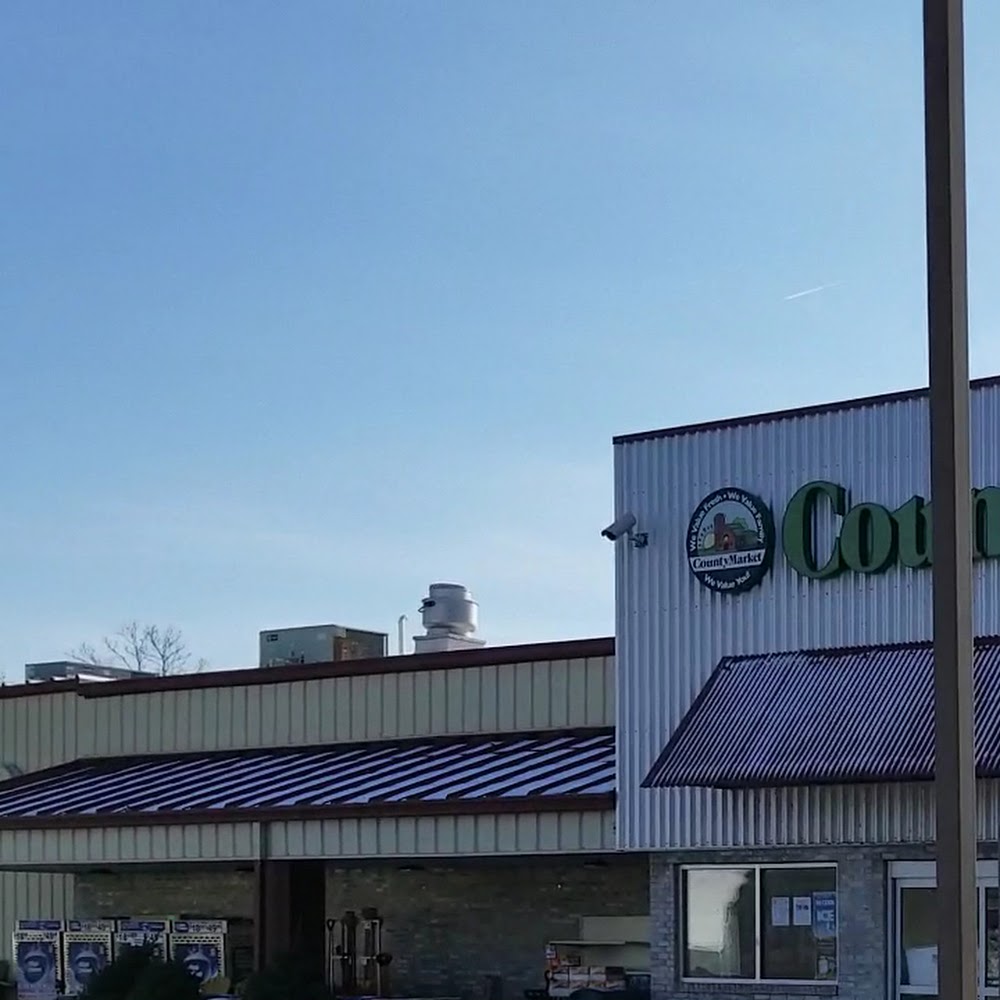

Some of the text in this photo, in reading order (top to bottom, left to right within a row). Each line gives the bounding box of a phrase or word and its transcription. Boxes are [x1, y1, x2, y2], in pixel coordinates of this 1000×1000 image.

[692, 511, 706, 533] Value
[705, 495, 723, 511] Fresh
[727, 491, 741, 501] We
[741, 494, 757, 513] Value
[704, 574, 715, 586] We
[716, 579, 736, 590] Value
